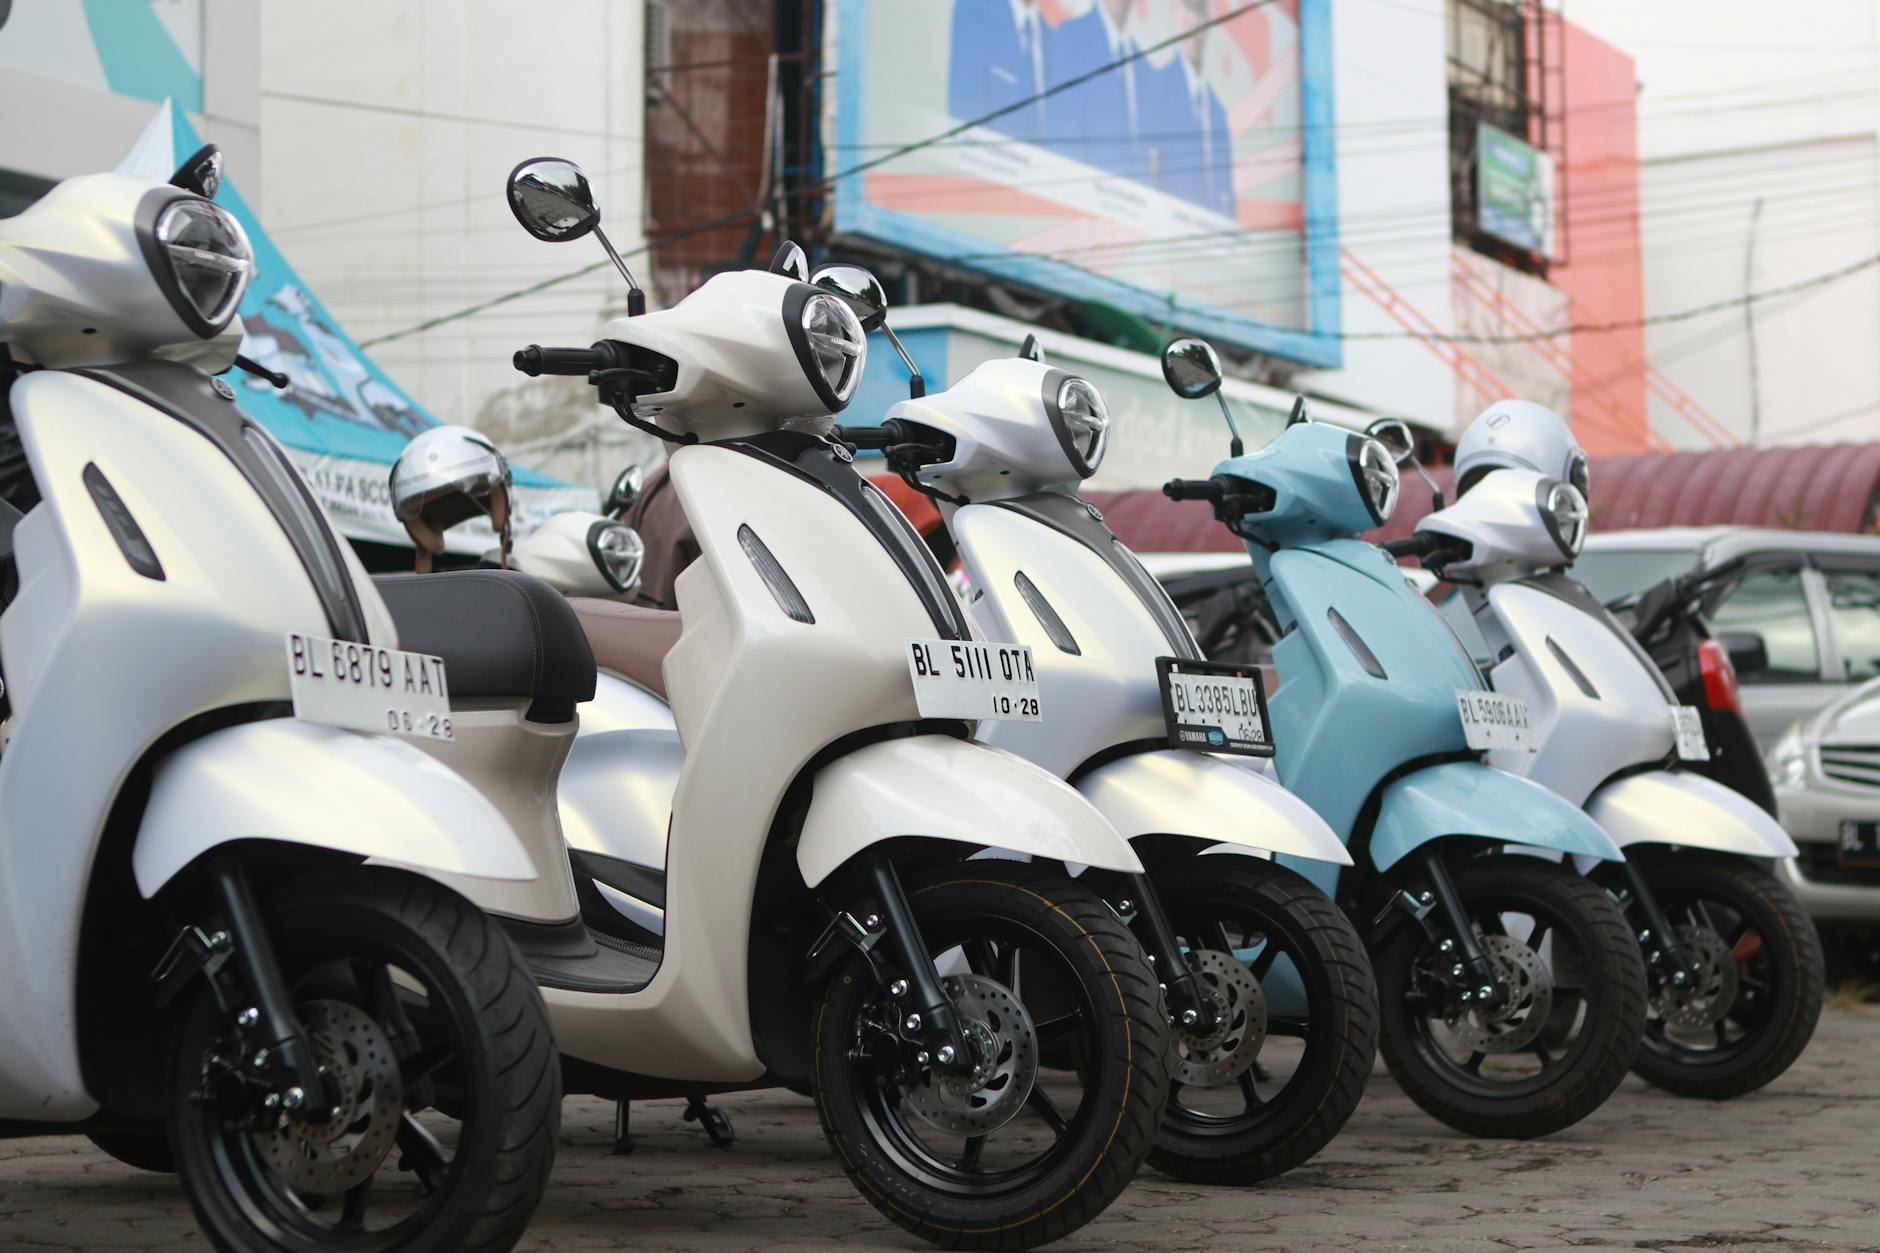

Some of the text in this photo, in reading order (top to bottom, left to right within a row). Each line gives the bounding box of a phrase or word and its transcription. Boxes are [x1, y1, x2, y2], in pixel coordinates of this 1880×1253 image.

[291, 634, 445, 698] BL 6879 AAT
[911, 643, 941, 676] BL
[950, 645, 992, 680] 5111
[1174, 683, 1258, 717] BL 3385 LBU
[1460, 697, 1479, 724] BL
